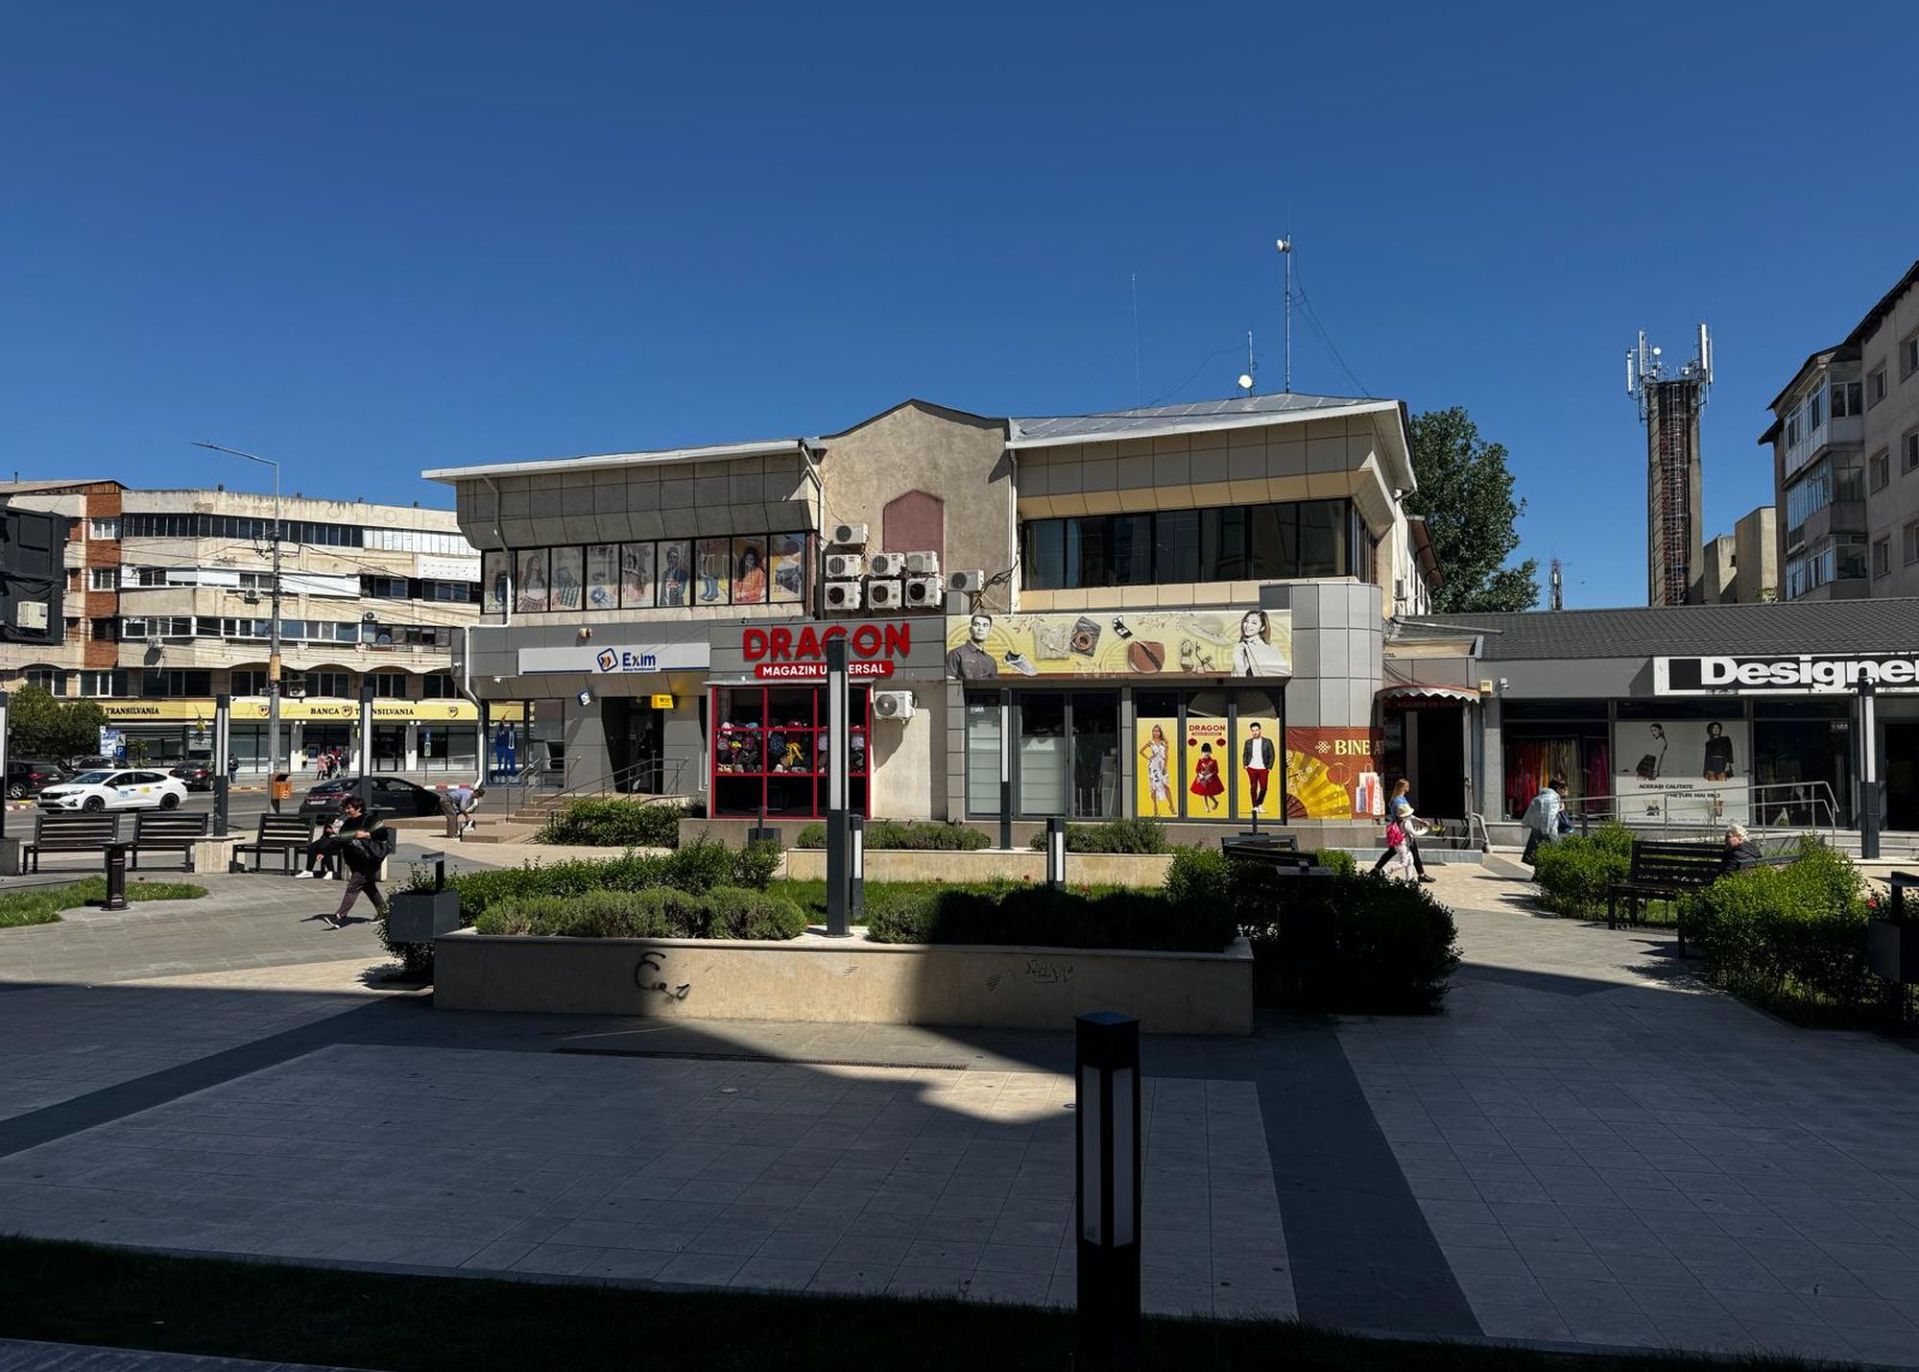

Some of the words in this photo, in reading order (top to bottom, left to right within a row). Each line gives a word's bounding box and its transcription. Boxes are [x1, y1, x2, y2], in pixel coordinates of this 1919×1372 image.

[622, 652, 656, 667] Exim
[763, 665, 817, 676] MAGAZIN
[820, 663, 885, 675] UERSAL
[105, 707, 160, 715] TRANSILVANIA
[354, 708, 415, 716] TNSILVANIA
[116, 746, 124, 756] P
[1334, 739, 1371, 756] BINE
